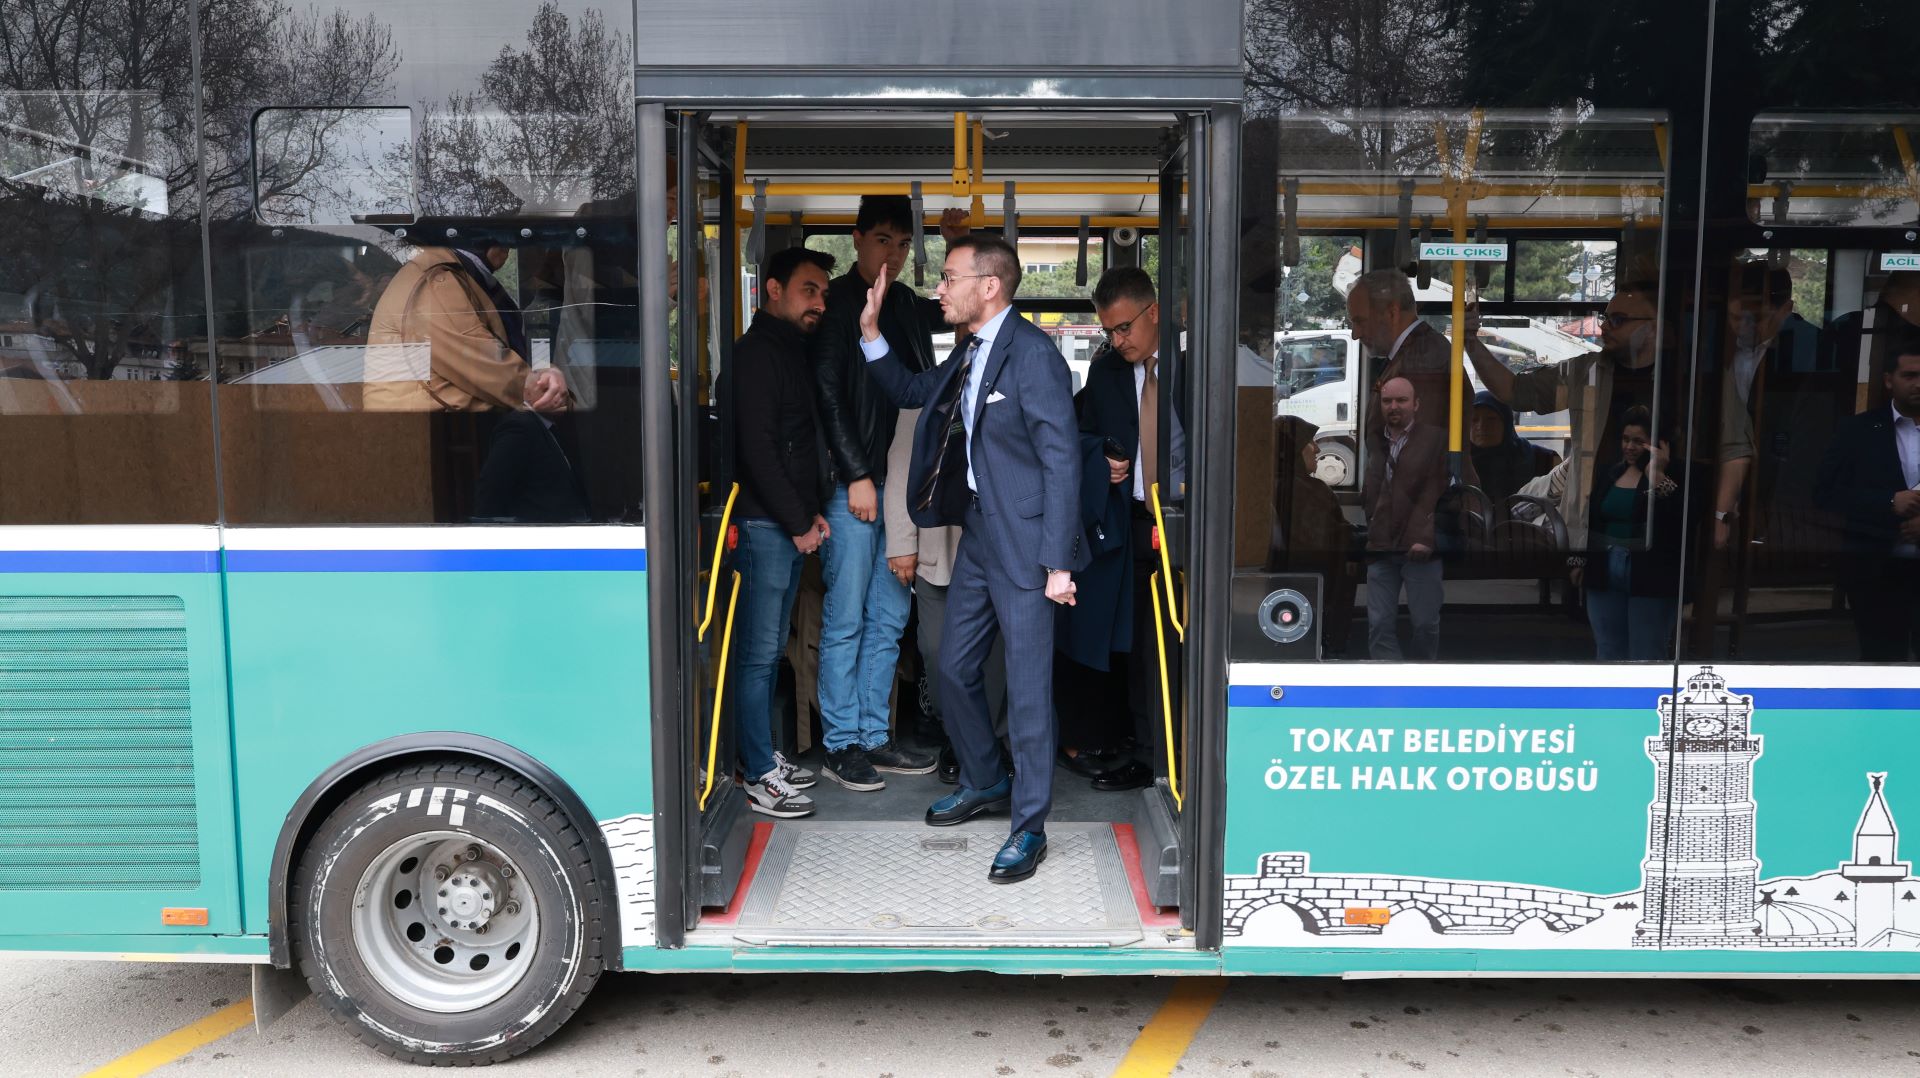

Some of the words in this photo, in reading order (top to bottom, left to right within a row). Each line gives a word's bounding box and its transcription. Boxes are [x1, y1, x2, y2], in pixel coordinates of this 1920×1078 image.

[1425, 247, 1459, 256] ACİL
[1463, 248, 1502, 258] ÇIKIŞ
[1885, 257, 1919, 266] ACİL
[1289, 728, 1395, 753] TOKAT
[1403, 723, 1576, 753] BELEDİYESİ
[1264, 758, 1342, 790] ÖZEL
[1351, 766, 1438, 790] HALK
[1446, 760, 1598, 792] OTOBÜSÜ
